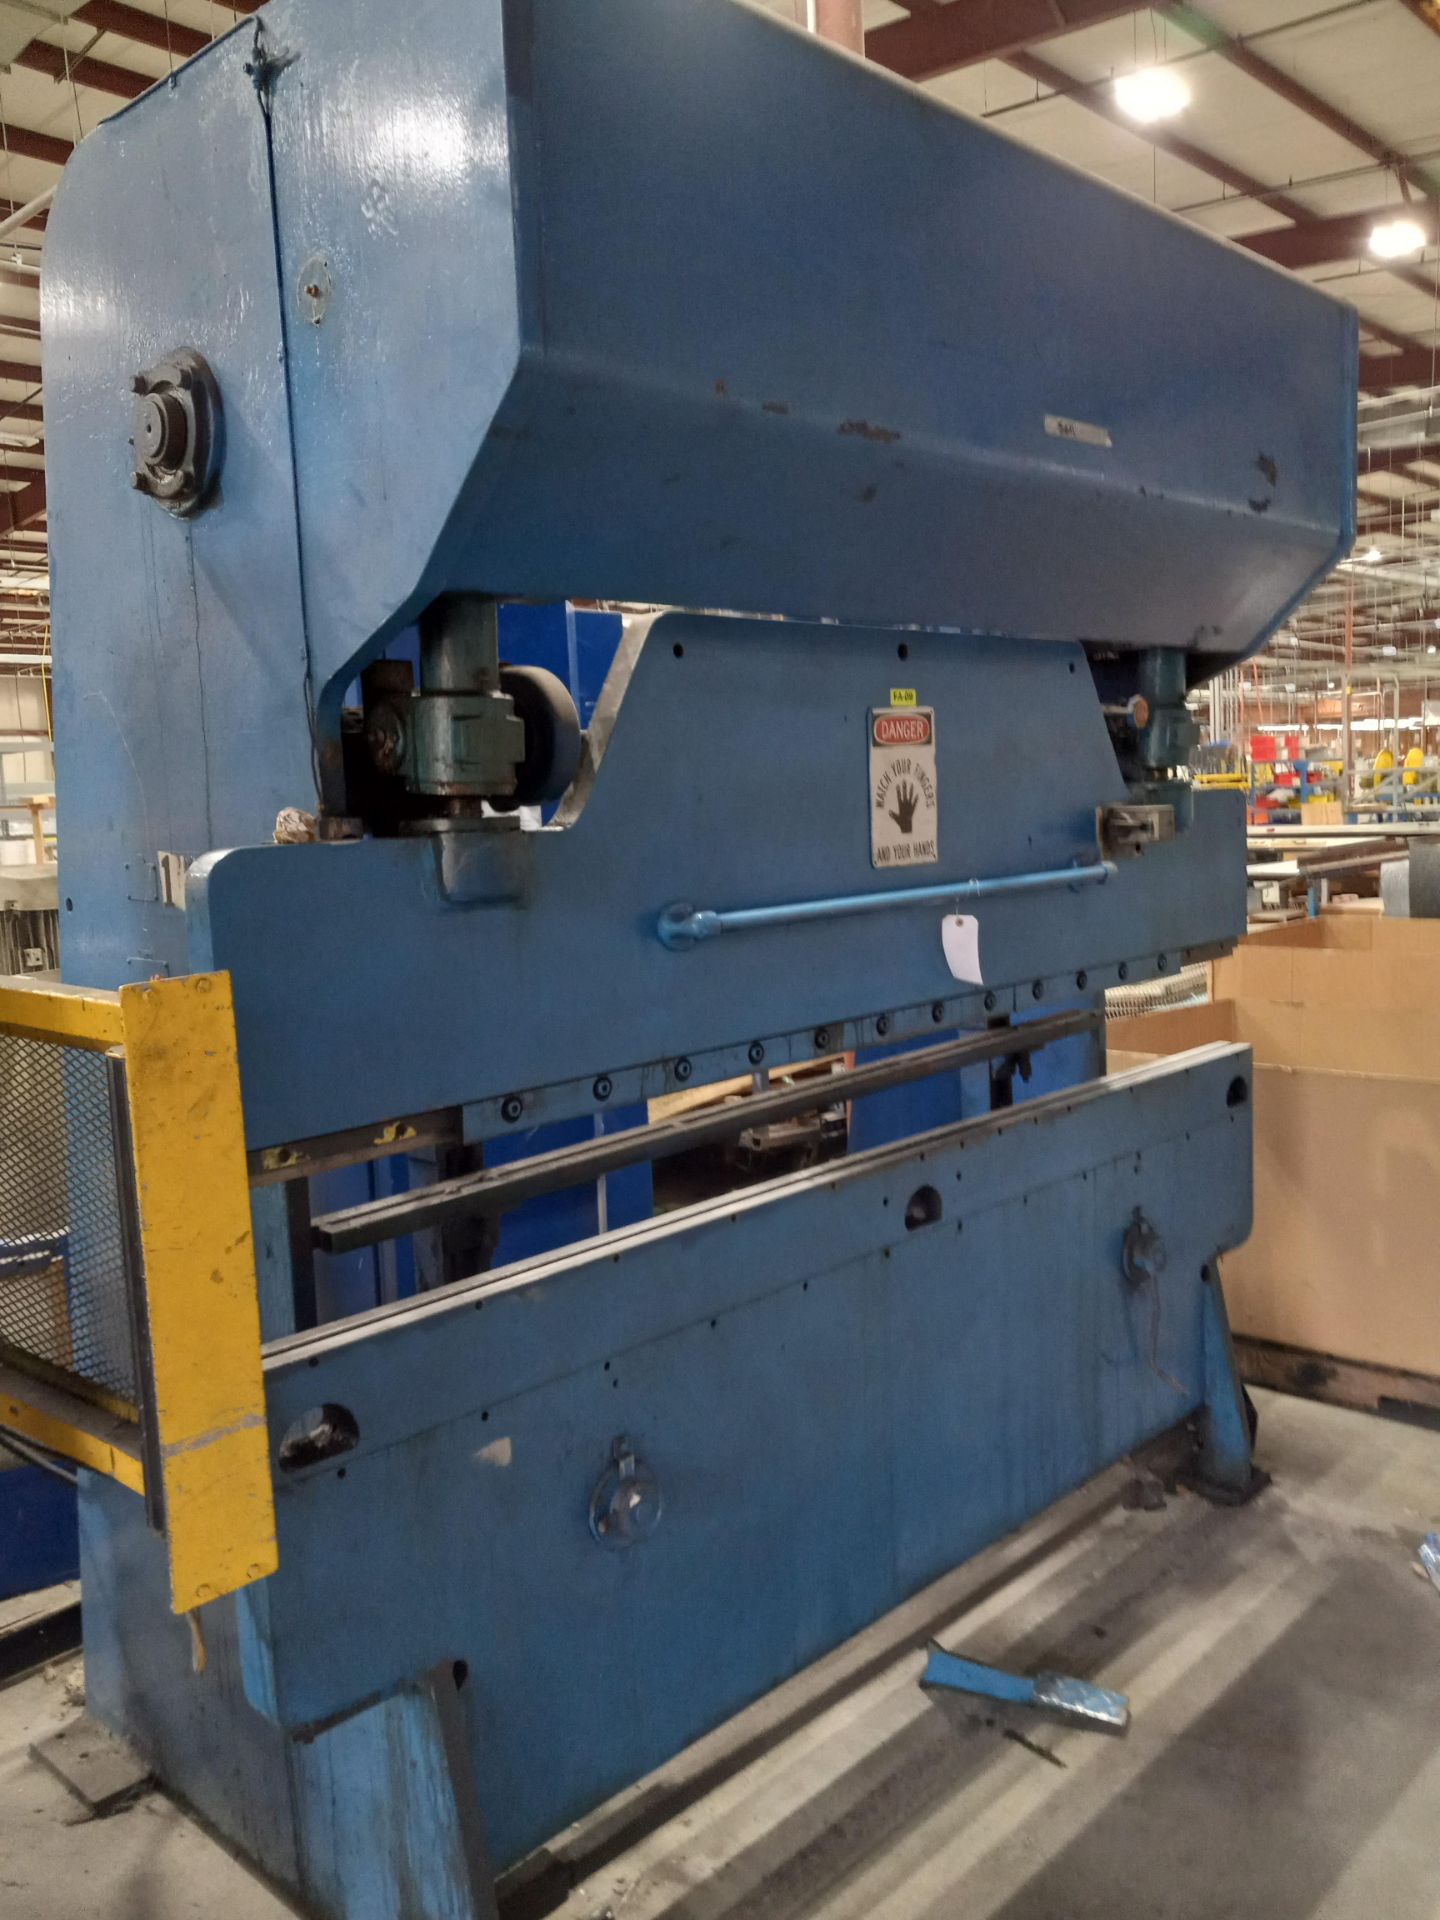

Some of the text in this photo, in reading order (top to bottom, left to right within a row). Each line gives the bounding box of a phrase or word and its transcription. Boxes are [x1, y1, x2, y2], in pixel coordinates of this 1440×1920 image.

[882, 720, 923, 740] DANGER
[876, 758, 935, 809] WATCH YOUR FINGERS
[877, 840, 935, 862] AND YOUR HANDS
